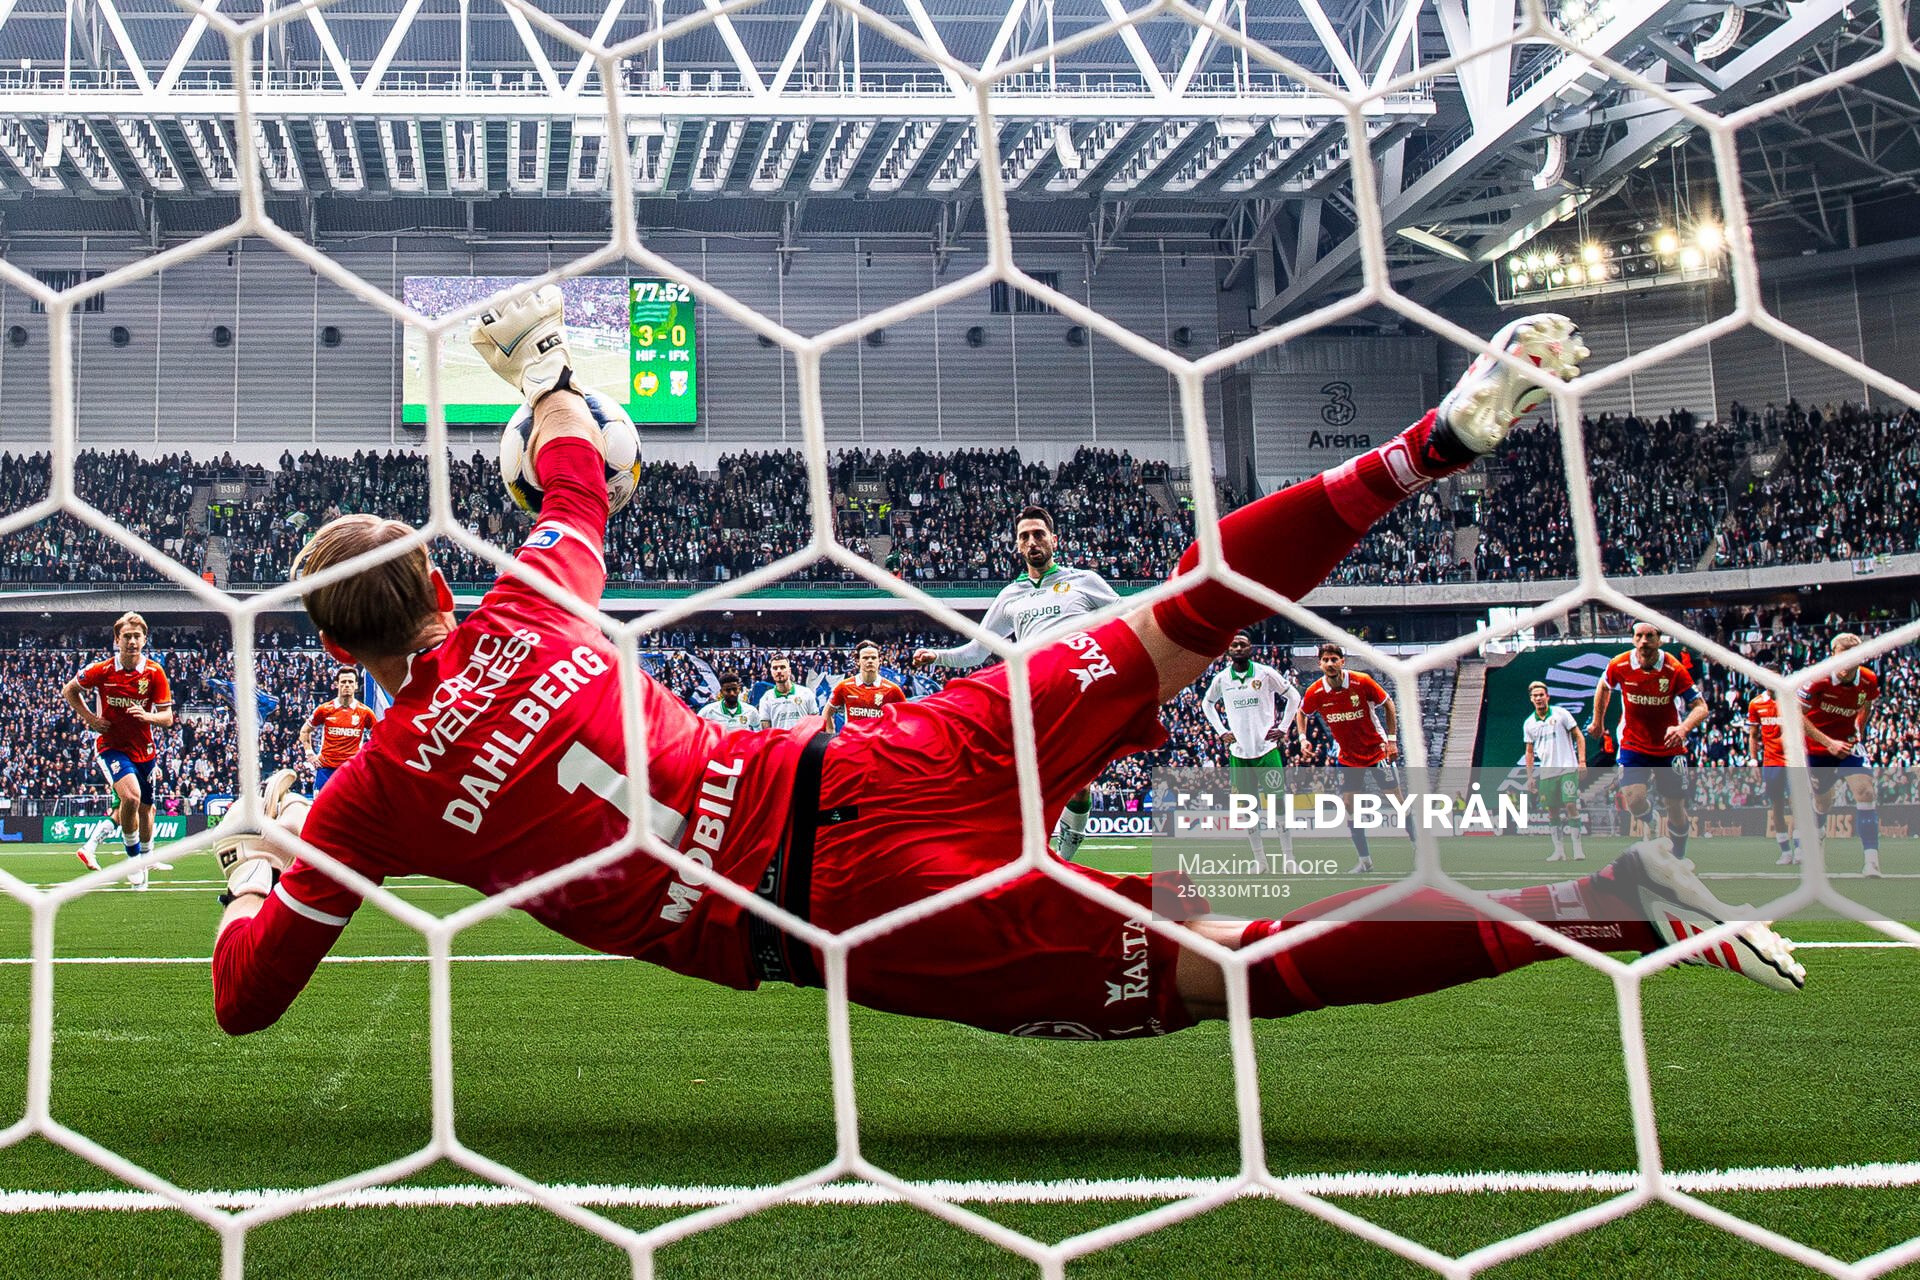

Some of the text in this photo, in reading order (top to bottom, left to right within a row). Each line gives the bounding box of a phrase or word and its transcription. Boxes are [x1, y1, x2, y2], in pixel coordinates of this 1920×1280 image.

[633, 283, 690, 302] 77:52
[638, 326, 653, 347] 3
[671, 326, 687, 347] 0
[635, 350, 657, 362] HIF
[668, 350, 690, 362] IFK
[1308, 431, 1370, 449] Arena
[1067, 632, 1117, 681] RAS
[411, 634, 502, 733] NORDIC
[405, 628, 542, 773] WELLNESS
[849, 707, 884, 718] SERNEK
[1326, 709, 1364, 723] SERNEKE
[442, 645, 609, 834] DAHLBERG
[557, 741, 688, 849] 1
[1086, 817, 1168, 833] ODGOLV
